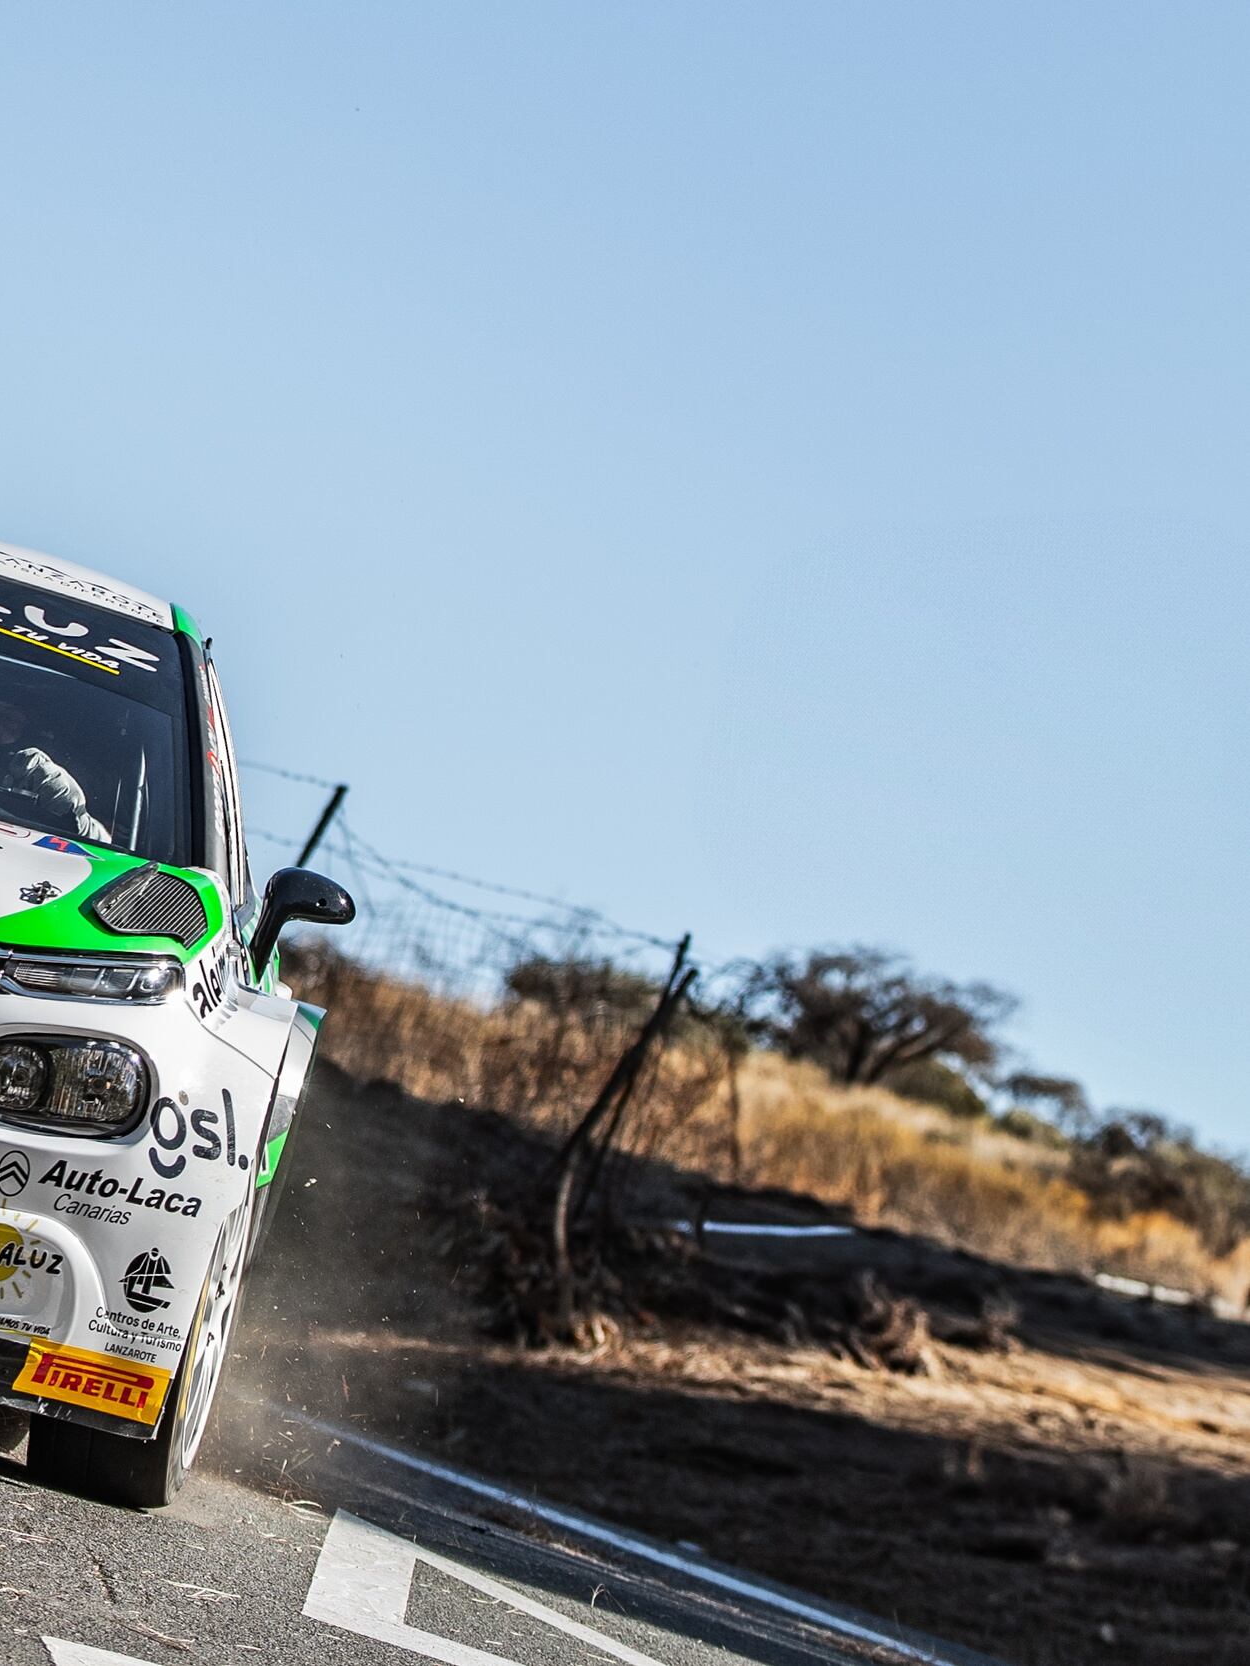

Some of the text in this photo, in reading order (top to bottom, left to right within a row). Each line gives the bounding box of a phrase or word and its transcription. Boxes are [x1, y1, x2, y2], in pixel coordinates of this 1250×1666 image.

[11, 624, 49, 642] TU
[57, 642, 120, 670] VIDA
[38, 1160, 203, 1218] Auto-Laca
[54, 1193, 132, 1225] Canarias
[21, 1322, 32, 1331] TU
[33, 1325, 51, 1335] VIDA
[88, 1319, 182, 1352] Cultura y Turismo
[96, 1307, 181, 1339] Centros de Arte,
[104, 1342, 157, 1363] LANZAROTE
[31, 1352, 155, 1409] PIRELLI
